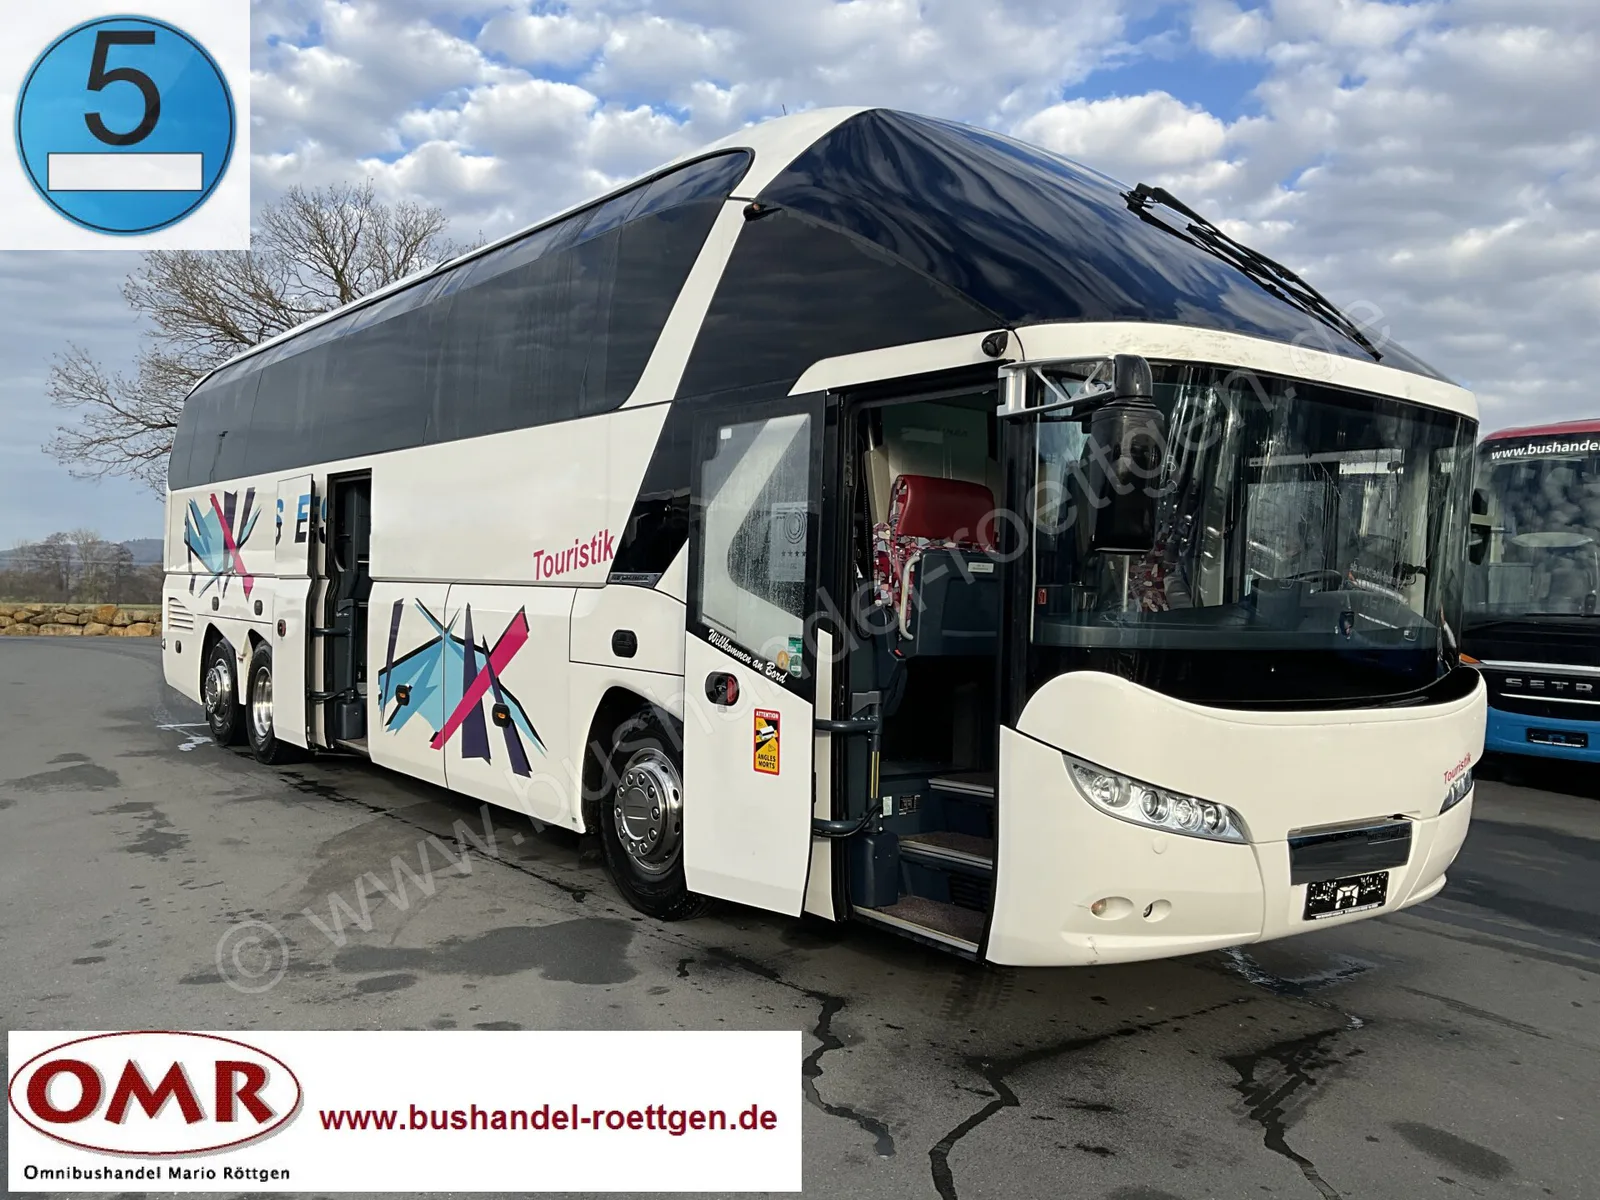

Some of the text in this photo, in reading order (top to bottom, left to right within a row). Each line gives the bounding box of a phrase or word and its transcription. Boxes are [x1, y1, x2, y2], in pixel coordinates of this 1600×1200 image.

[533, 529, 615, 580] Touristik
[708, 628, 788, 684] Willkommen an Bord
[757, 753, 776, 763] ANGLES
[758, 760, 775, 769] MORTS
[1443, 752, 1472, 785] Touristik
